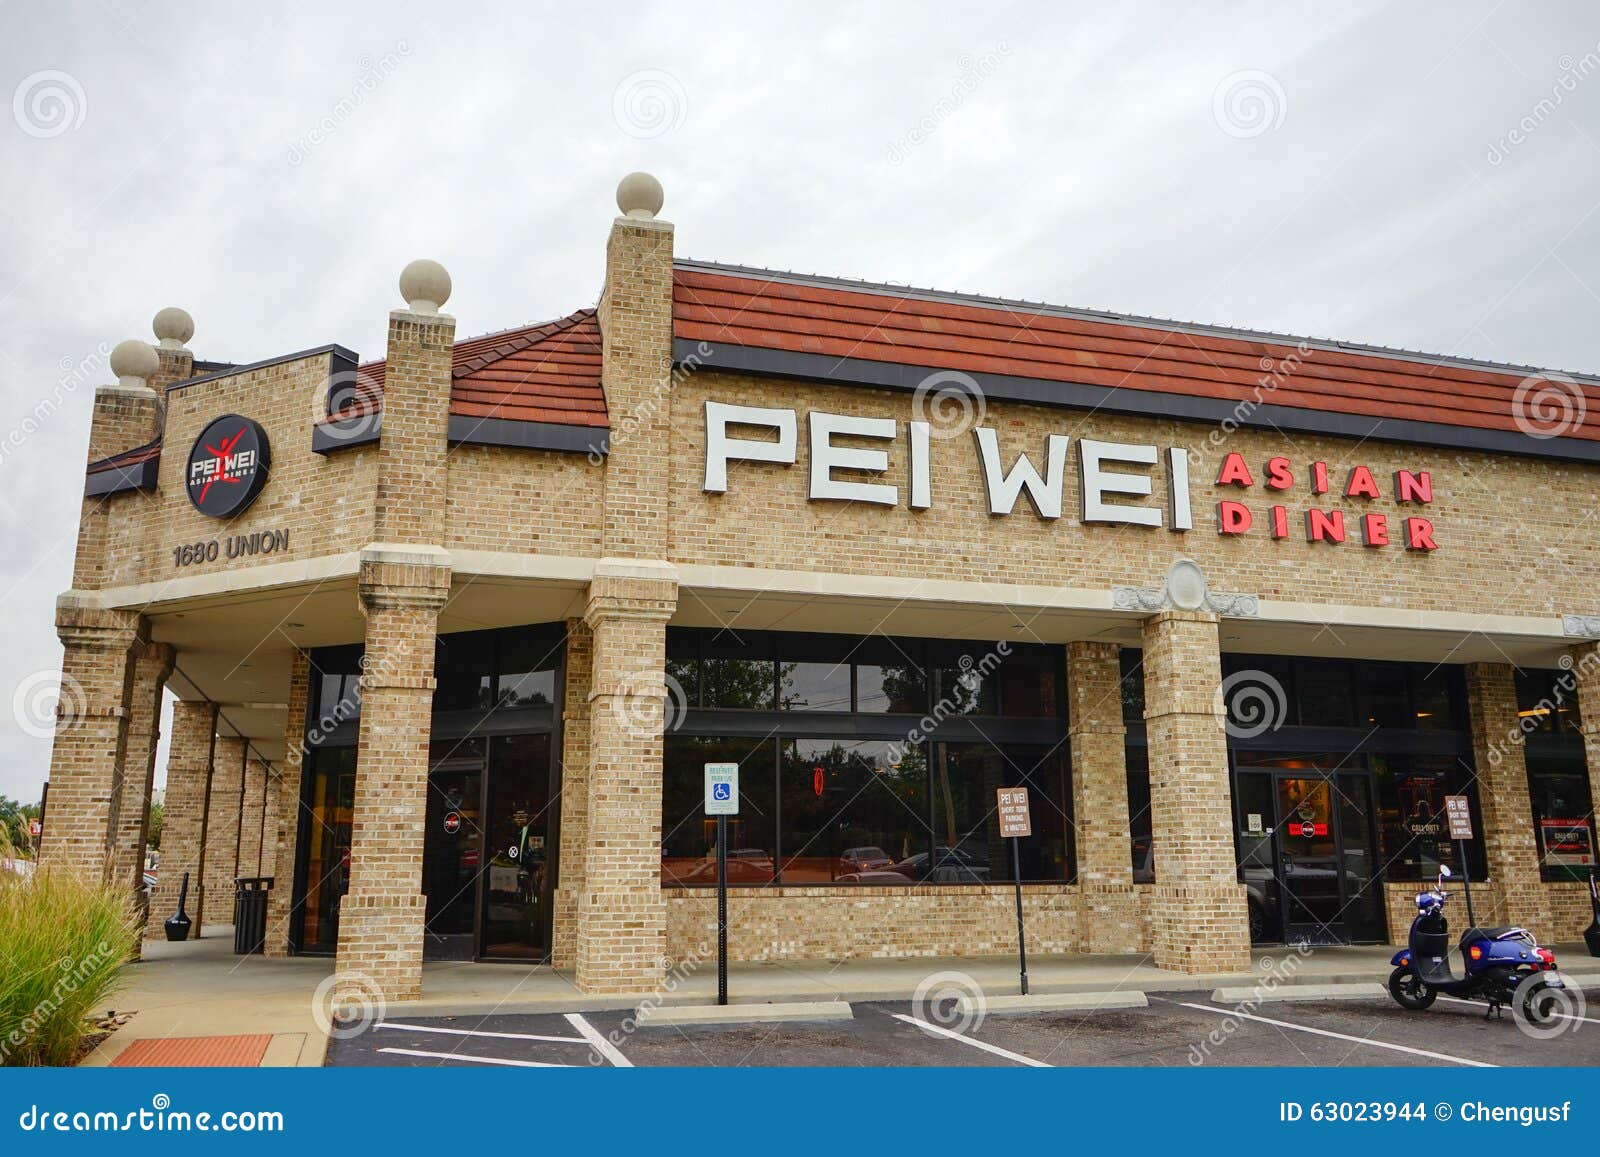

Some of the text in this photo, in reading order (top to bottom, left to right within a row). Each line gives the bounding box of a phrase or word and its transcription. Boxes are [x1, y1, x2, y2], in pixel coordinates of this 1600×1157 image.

[189, 474, 220, 486] ASIAN
[191, 449, 256, 478] PEI WEI
[702, 400, 1193, 531] PEI WEI
[1215, 452, 1434, 504] ASIAN
[1216, 500, 1439, 551] DINER
[173, 528, 289, 567] 1680 UNION
[1013, 792, 1025, 803] WEI
